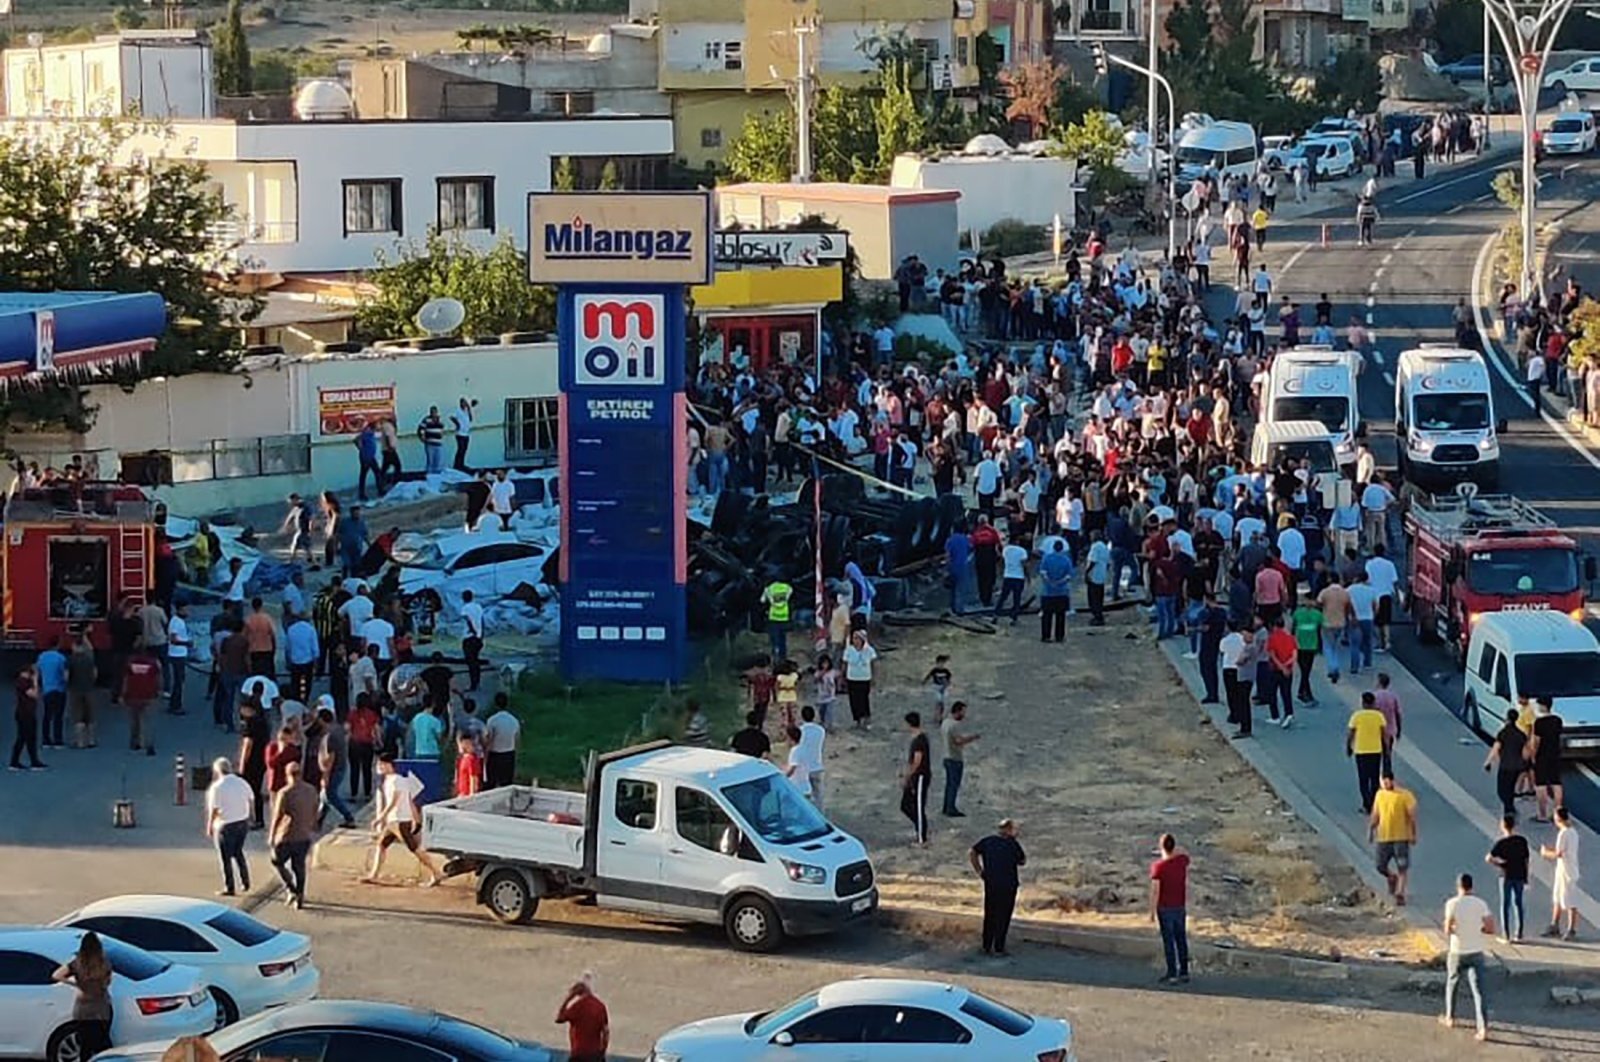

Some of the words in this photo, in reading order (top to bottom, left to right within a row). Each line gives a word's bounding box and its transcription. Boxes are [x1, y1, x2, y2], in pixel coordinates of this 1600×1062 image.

[545, 217, 692, 259] Milangaz
[584, 343, 654, 378] oil
[590, 410, 652, 420] PETROL
